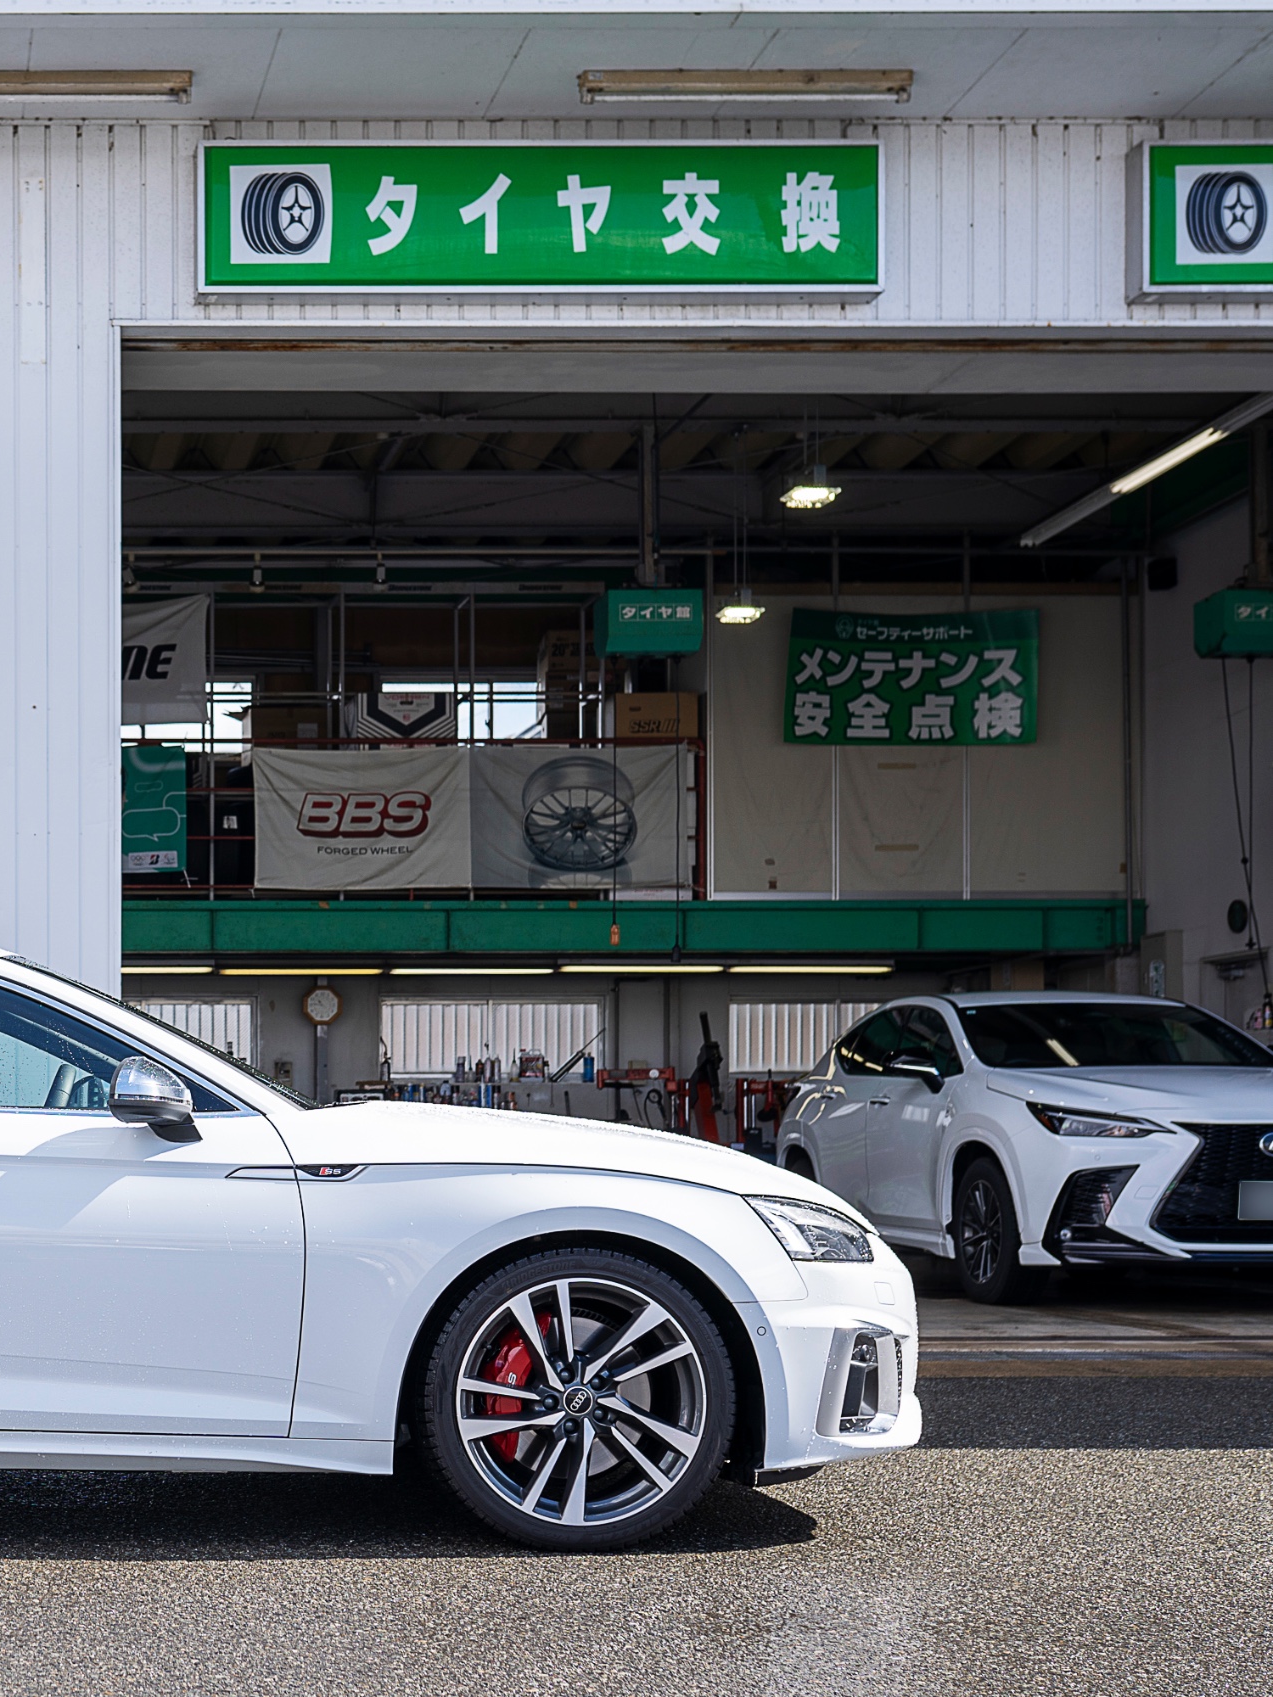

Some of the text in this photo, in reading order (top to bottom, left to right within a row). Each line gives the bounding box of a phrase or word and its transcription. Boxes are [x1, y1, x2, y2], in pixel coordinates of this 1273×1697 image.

[365, 171, 842, 257] タイヤ交換
[620, 604, 692, 620] タイヤ館
[855, 625, 974, 641] セーフティーサポート
[794, 647, 1024, 690] メンテナンス
[793, 691, 1024, 740] 安全点検
[296, 790, 433, 839] BBS
[317, 845, 414, 856] FORGED WHEEL
